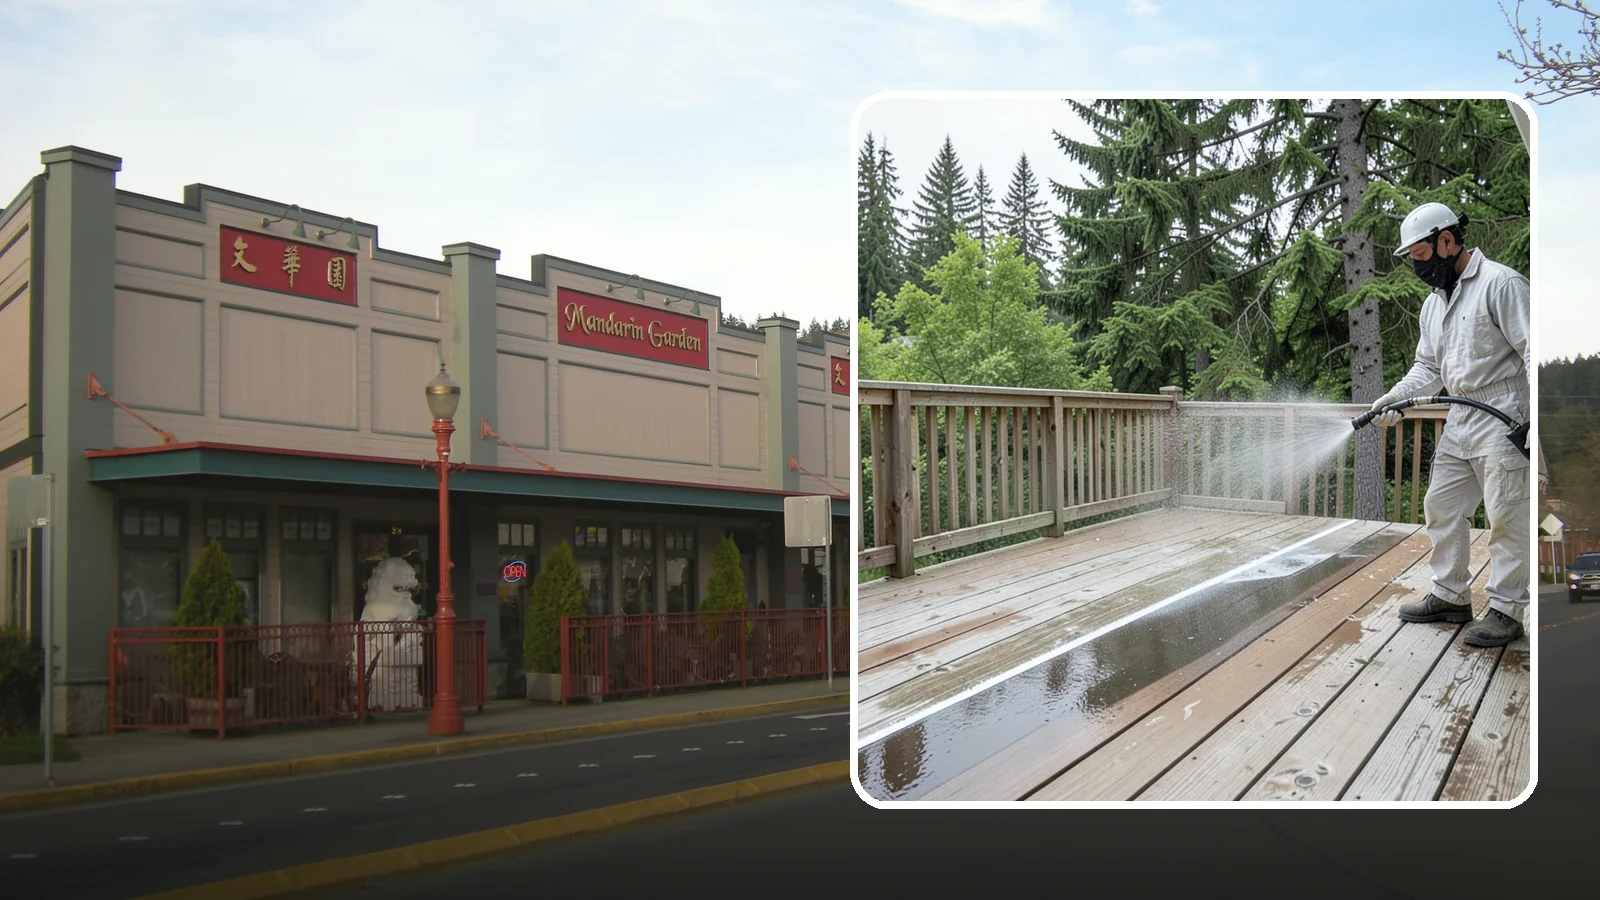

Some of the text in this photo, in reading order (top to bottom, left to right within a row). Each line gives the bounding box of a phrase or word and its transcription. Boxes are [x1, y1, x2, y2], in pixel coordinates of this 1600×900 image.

[231, 236, 346, 291] 文華園
[564, 302, 701, 352] Mandarin Garden
[834, 362, 846, 386] 文
[503, 565, 527, 578] OPEN
